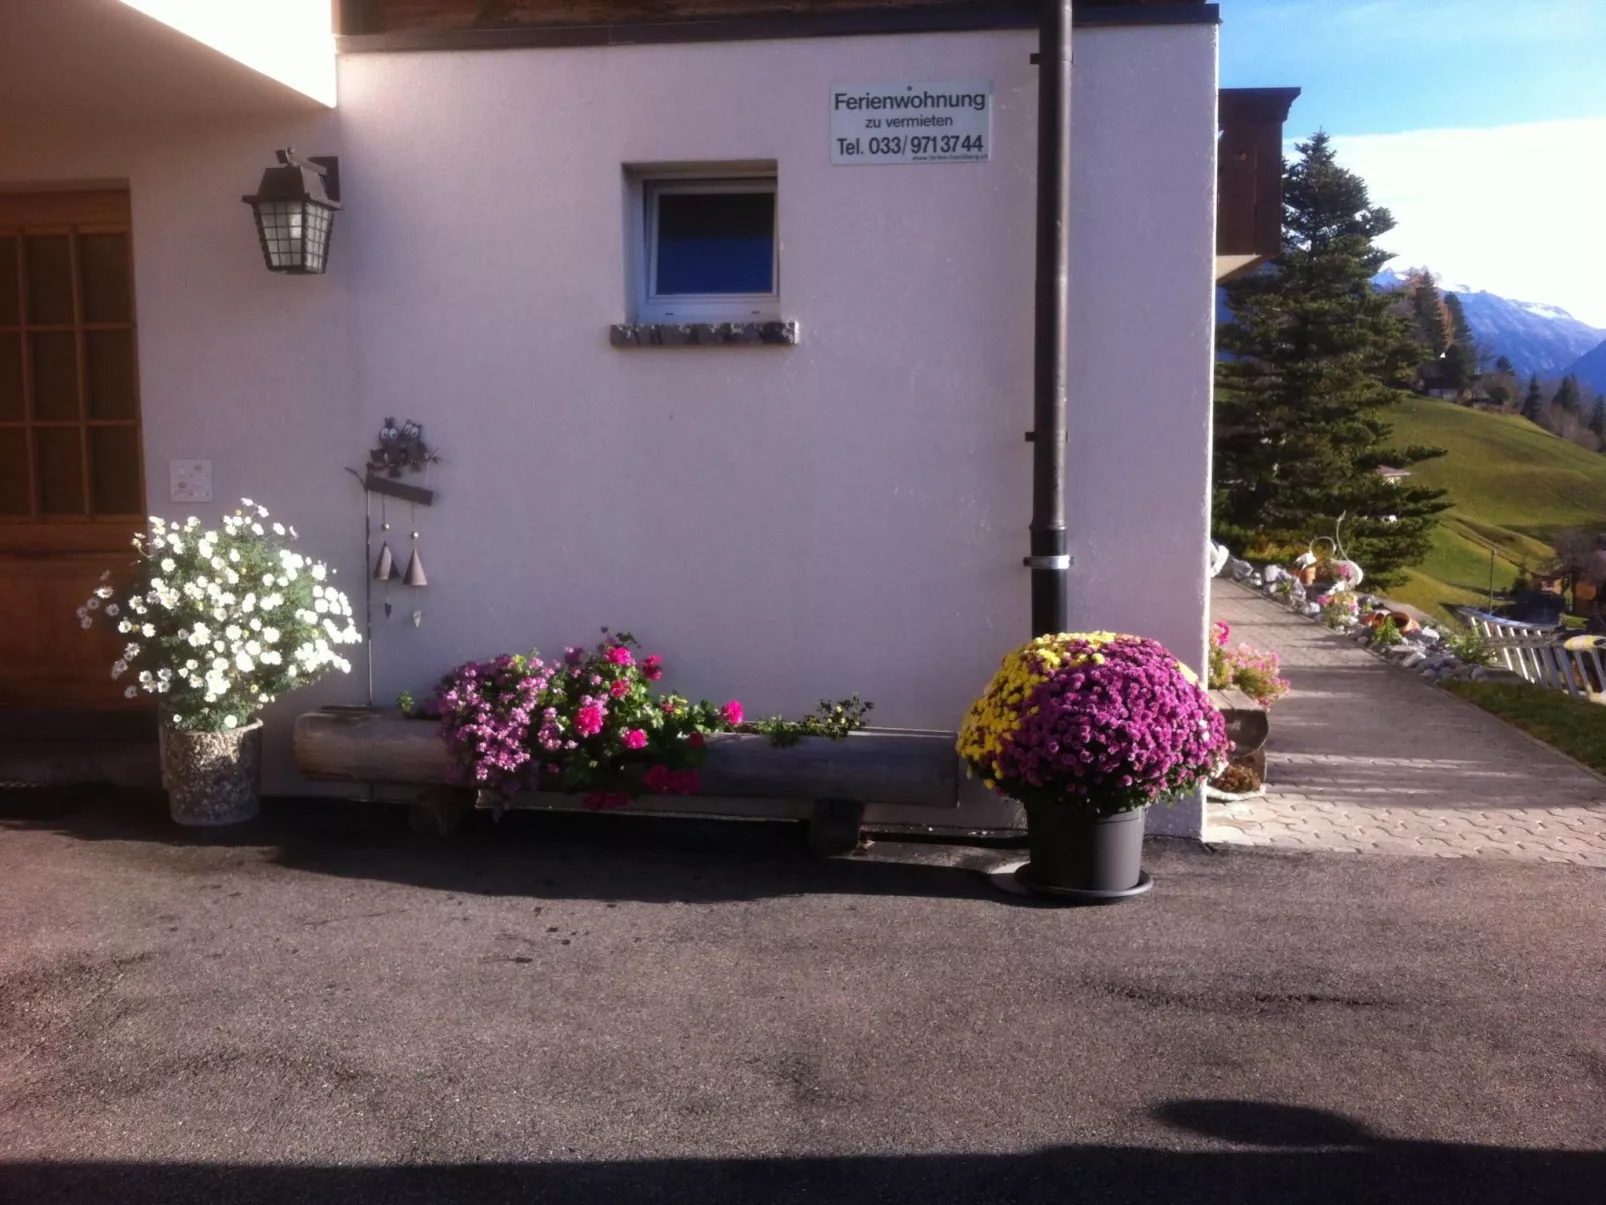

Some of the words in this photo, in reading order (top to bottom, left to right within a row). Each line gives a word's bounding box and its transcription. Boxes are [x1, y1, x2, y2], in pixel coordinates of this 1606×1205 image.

[834, 91, 986, 111] Ferienwohnung
[865, 118, 882, 129] zu
[886, 114, 953, 128] vermieten
[836, 138, 864, 155] Tel.
